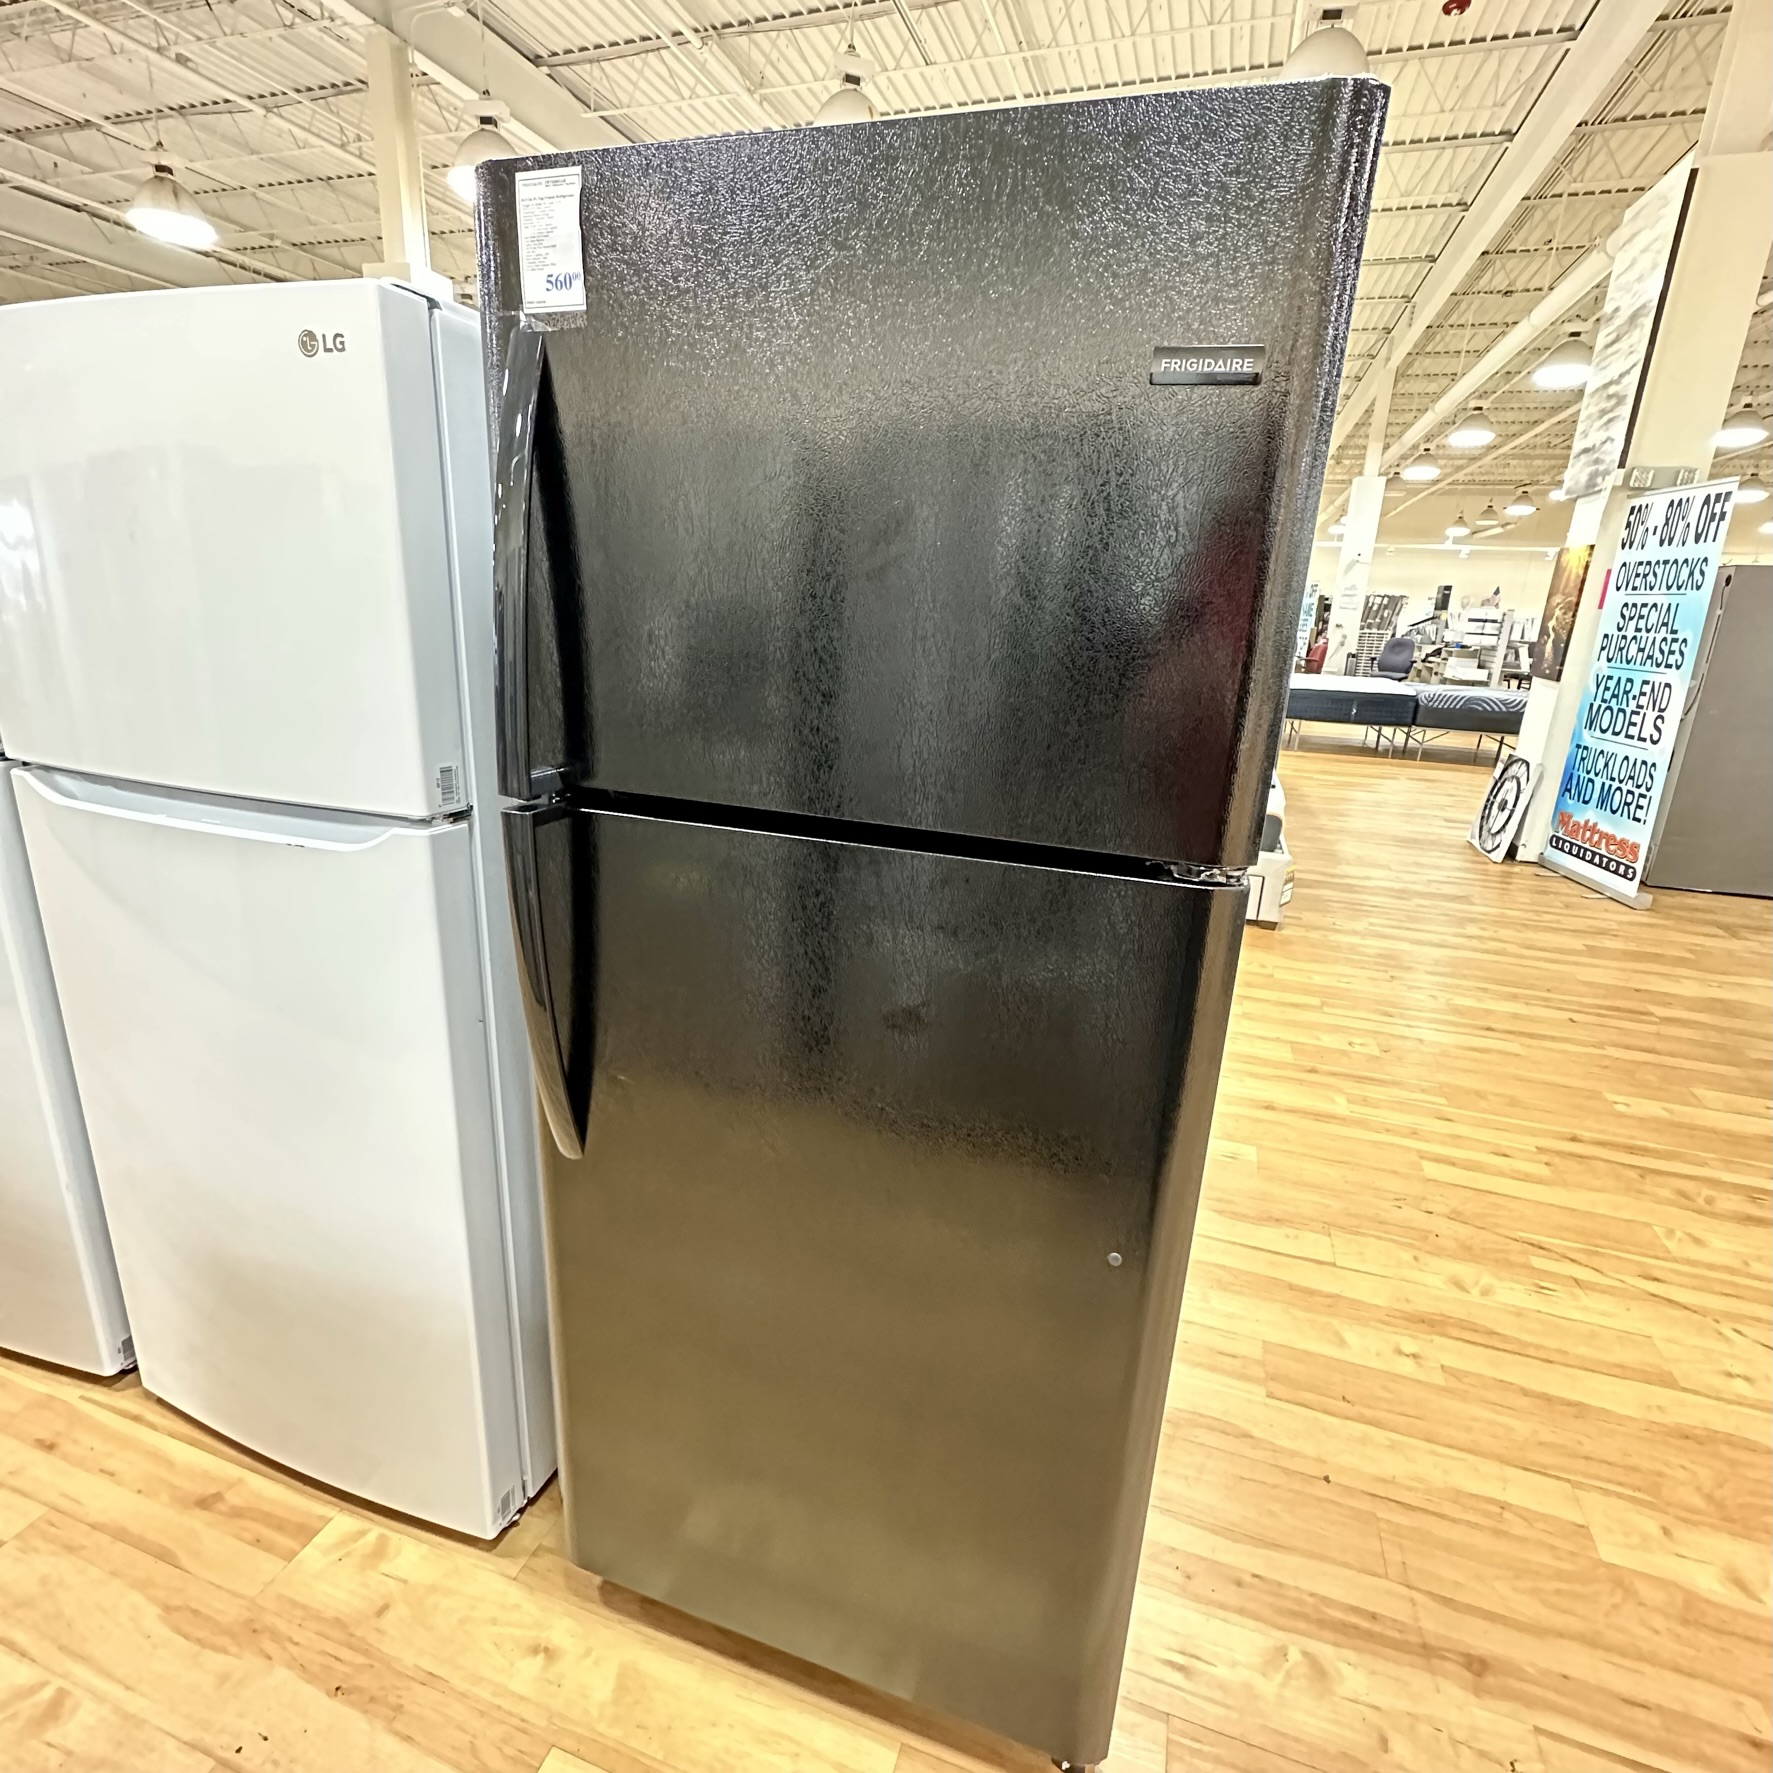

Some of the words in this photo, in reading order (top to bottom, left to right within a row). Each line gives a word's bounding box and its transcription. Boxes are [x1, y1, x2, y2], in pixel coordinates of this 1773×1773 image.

[322, 333, 346, 353] LG
[1160, 358, 1254, 372] FRIGIDAIRE
[1621, 502, 1654, 551] 50%
[1659, 495, 1696, 548] 80%
[1694, 491, 1733, 545] OFF
[1615, 556, 1709, 592] OVERSTOCKS
[1616, 602, 1679, 635] SPECIAL
[1597, 633, 1688, 671] PURCHASES
[1593, 673, 1672, 713] YEAR-END
[1584, 702, 1665, 745] MODELS
[1572, 743, 1657, 793] TRUCKLOADS
[1561, 772, 1595, 806] AND
[1596, 781, 1652, 825] MORE!
[1554, 810, 1640, 863] Mattress
[1551, 837, 1634, 879] LIQUIDATORS
